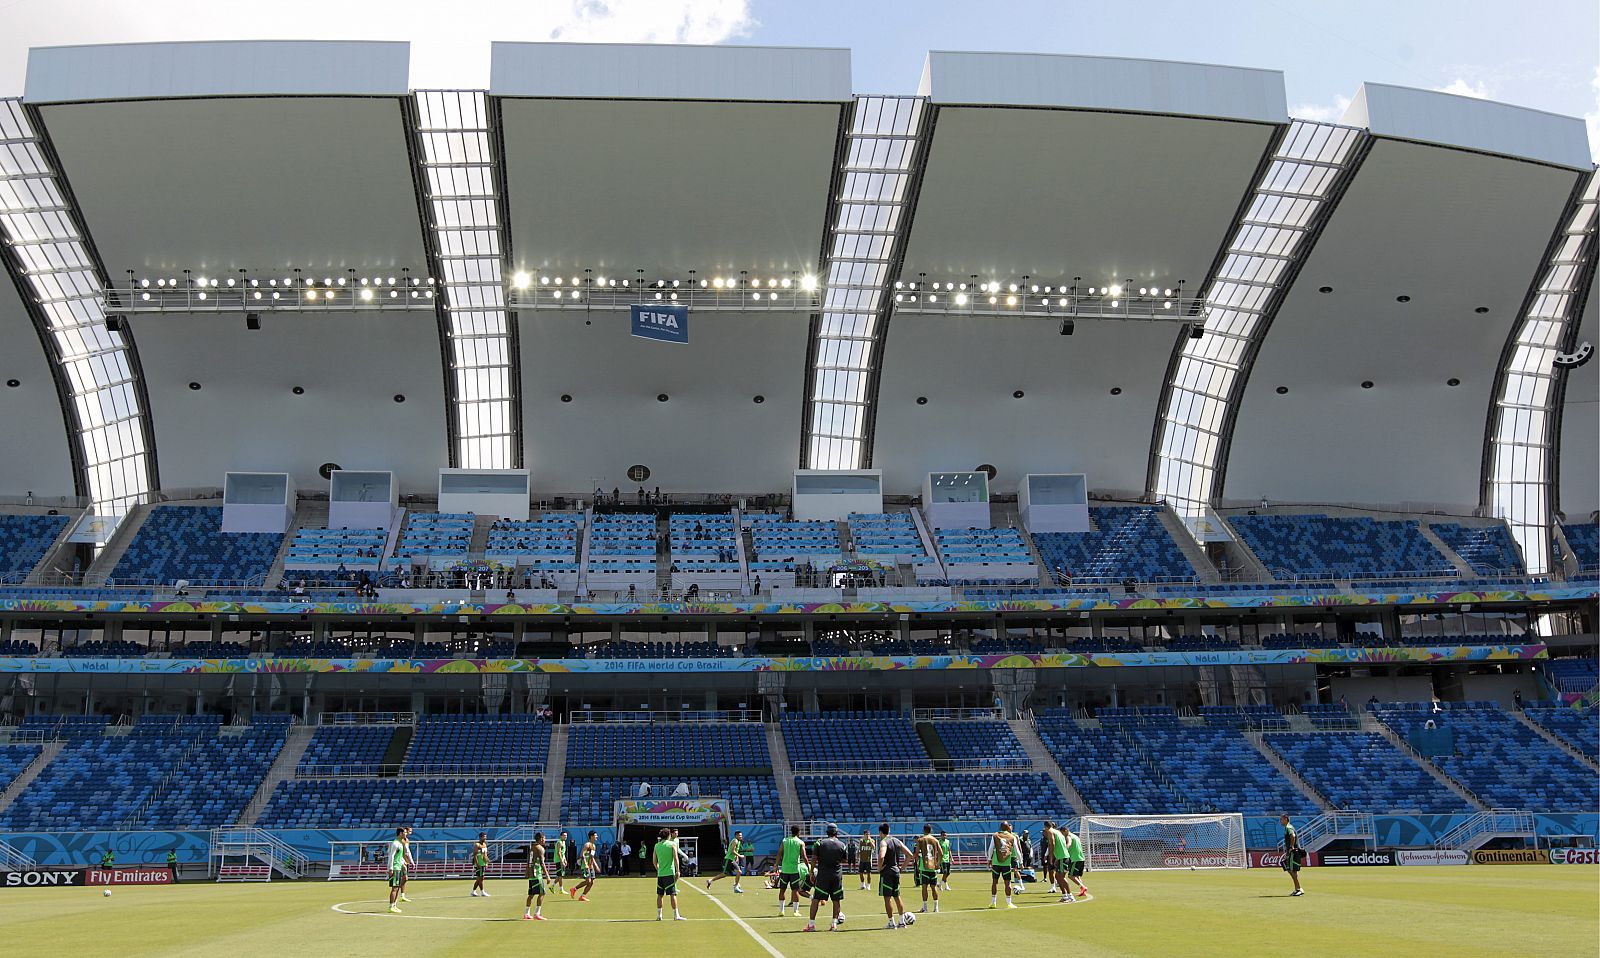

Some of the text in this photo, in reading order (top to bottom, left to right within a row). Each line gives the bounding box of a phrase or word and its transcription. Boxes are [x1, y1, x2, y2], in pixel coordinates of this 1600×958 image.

[640, 311, 679, 328] FIFA
[1195, 654, 1220, 663] Natal
[82, 662, 109, 670] Natal
[604, 660, 723, 671] 2014 FIFA World Cup Brazil
[675, 813, 686, 821] Cup
[1183, 857, 1199, 866] KIA
[1201, 856, 1239, 866] MOTORS
[1349, 853, 1390, 864] adidas
[1474, 849, 1537, 864] Continental
[6, 871, 79, 886] SONY
[90, 869, 168, 885] Fly Emirates
